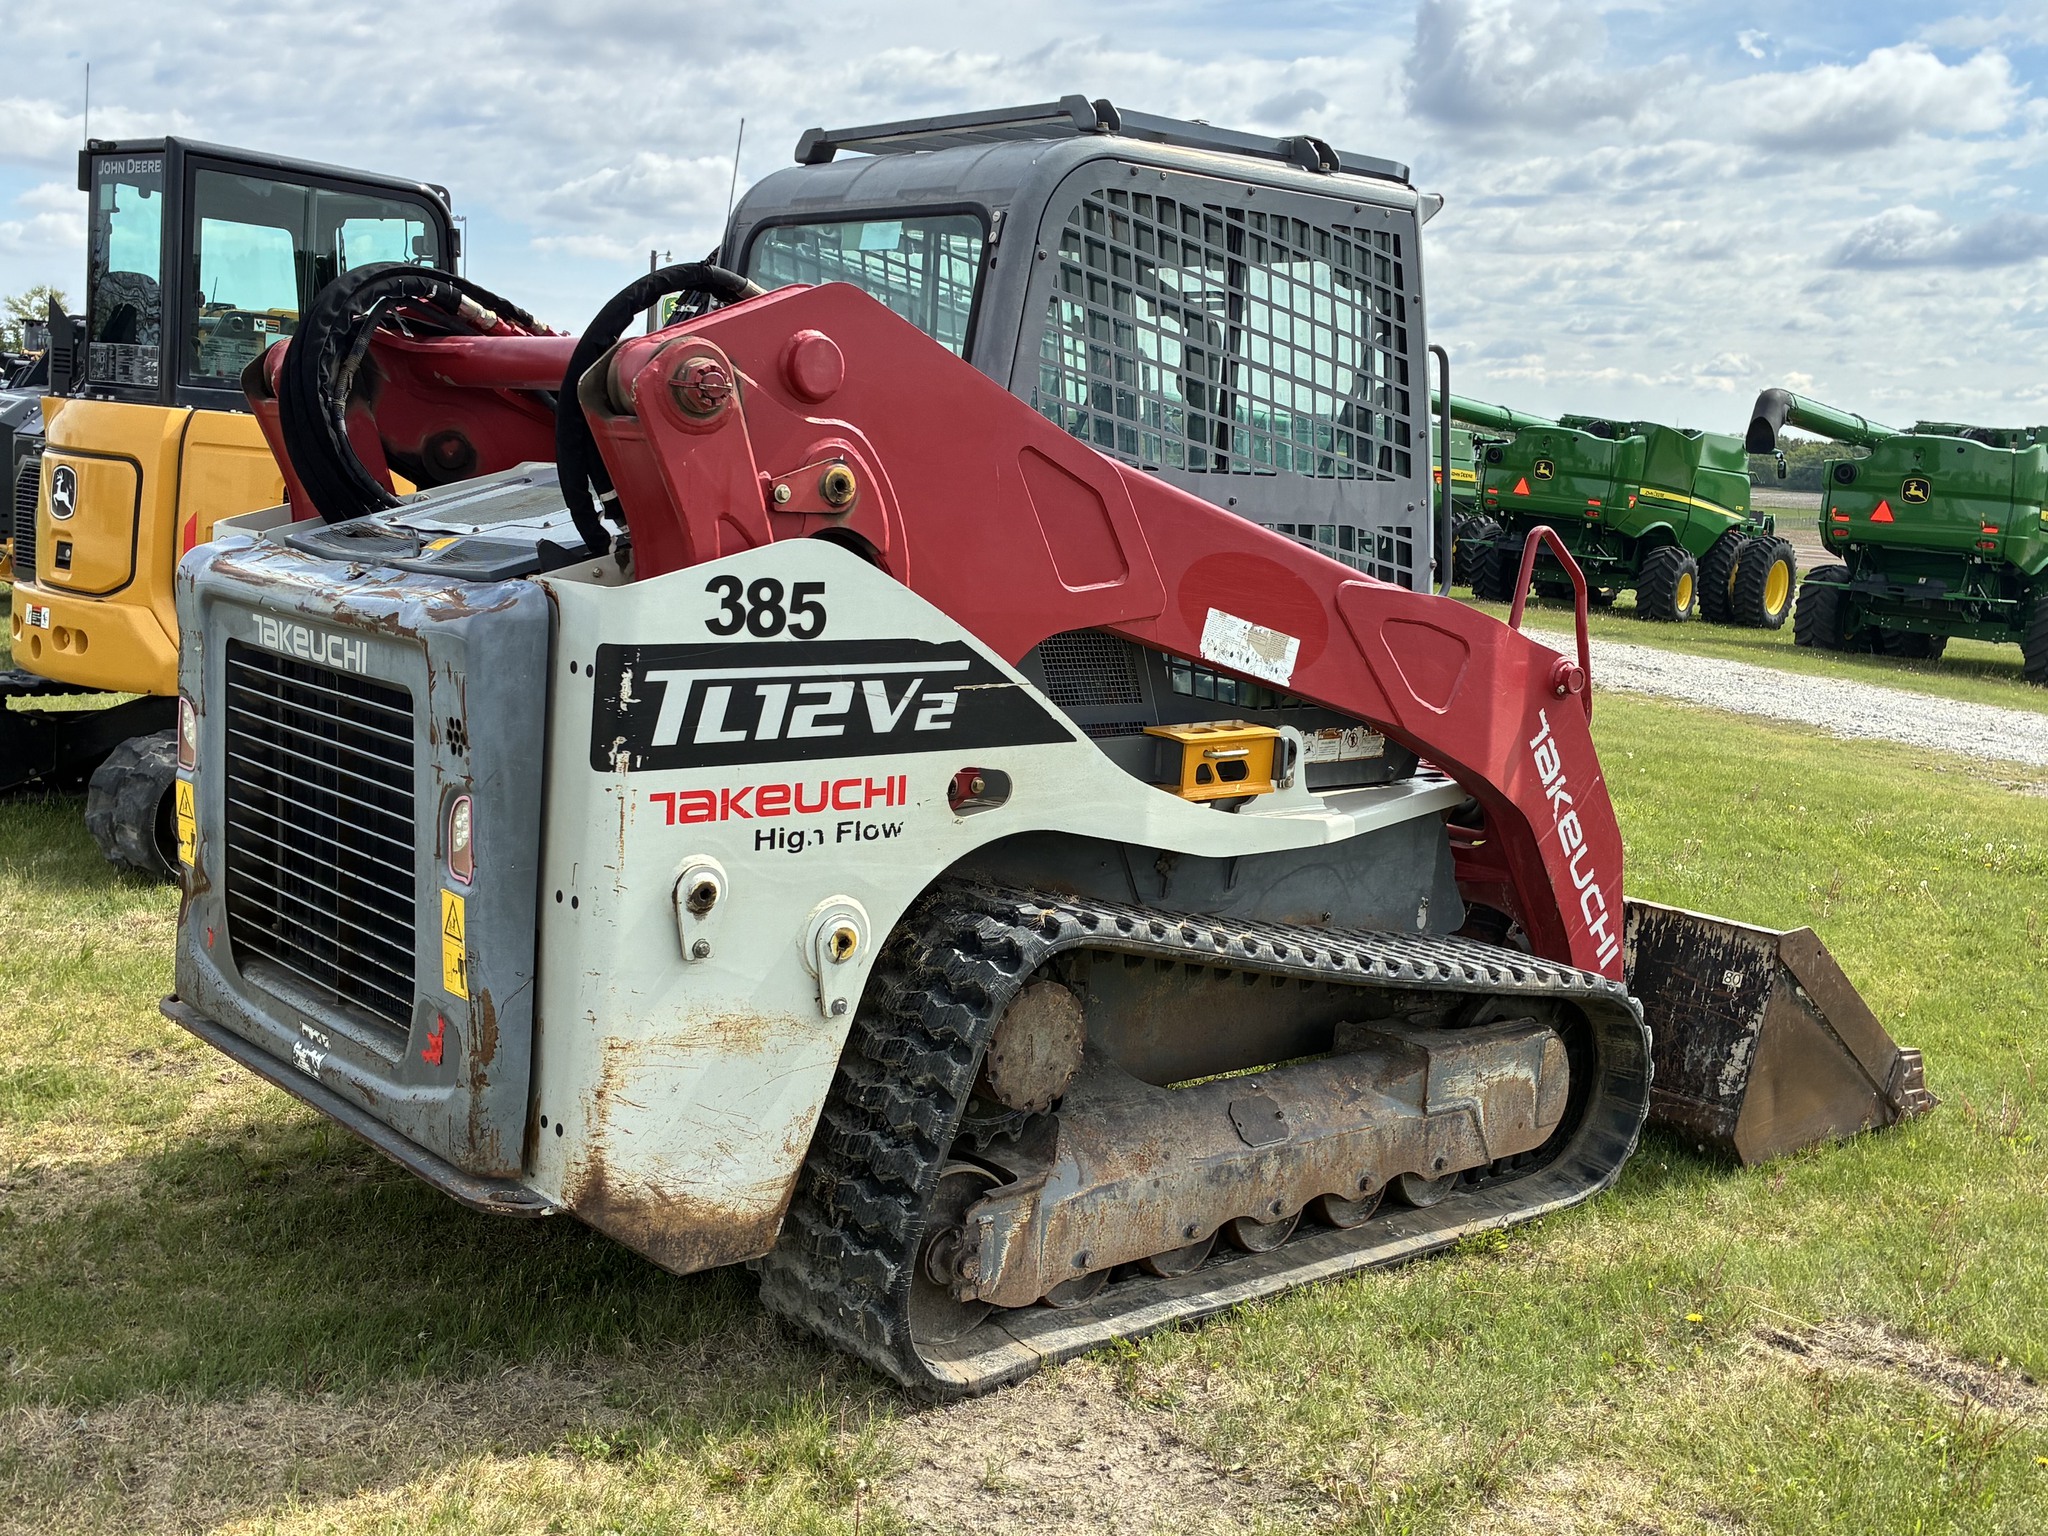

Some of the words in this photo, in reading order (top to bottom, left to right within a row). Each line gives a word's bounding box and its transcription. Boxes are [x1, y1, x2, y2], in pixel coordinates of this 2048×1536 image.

[98, 160, 125, 175] JOHN
[127, 158, 162, 174] DEERE
[704, 574, 827, 640] 385
[252, 613, 368, 674] TAKEUCHI
[649, 774, 907, 826] TAKEUCHI
[836, 820, 904, 843] Flow
[1723, 971, 1741, 986] 80
